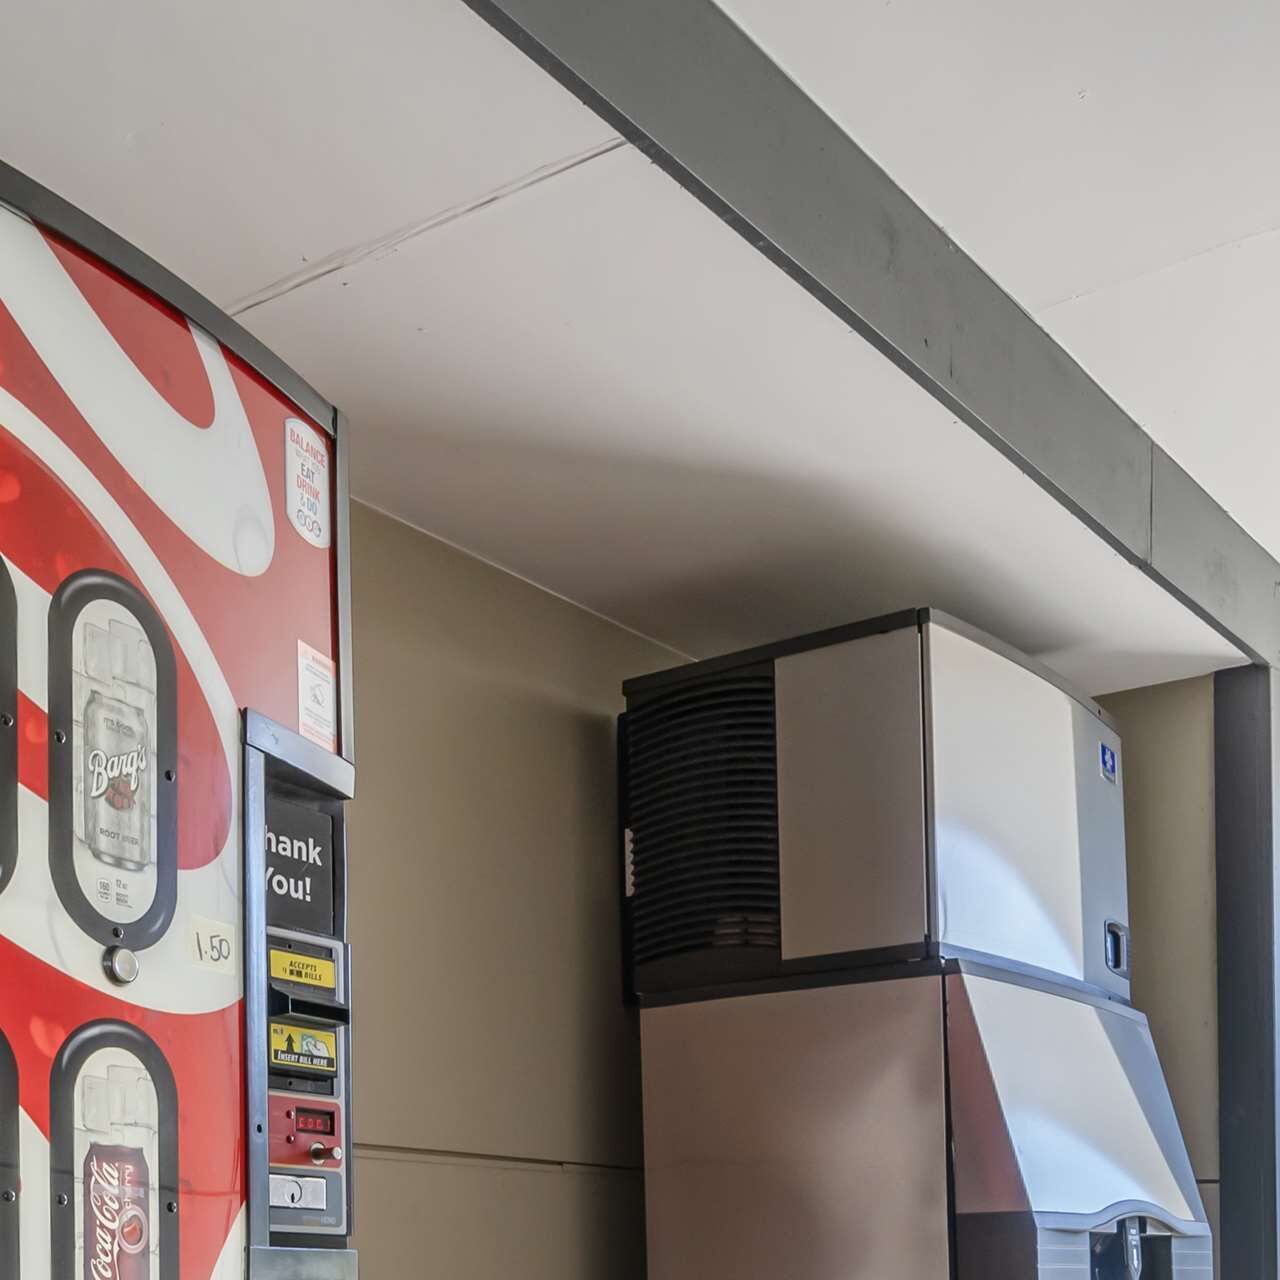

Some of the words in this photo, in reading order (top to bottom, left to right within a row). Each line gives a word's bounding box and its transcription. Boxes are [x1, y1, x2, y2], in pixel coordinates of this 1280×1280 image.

[88, 744, 146, 798] Barq's
[265, 824, 322, 866] hank
[196, 931, 231, 961] 1.50
[289, 960, 317, 972] ACCEPTS
